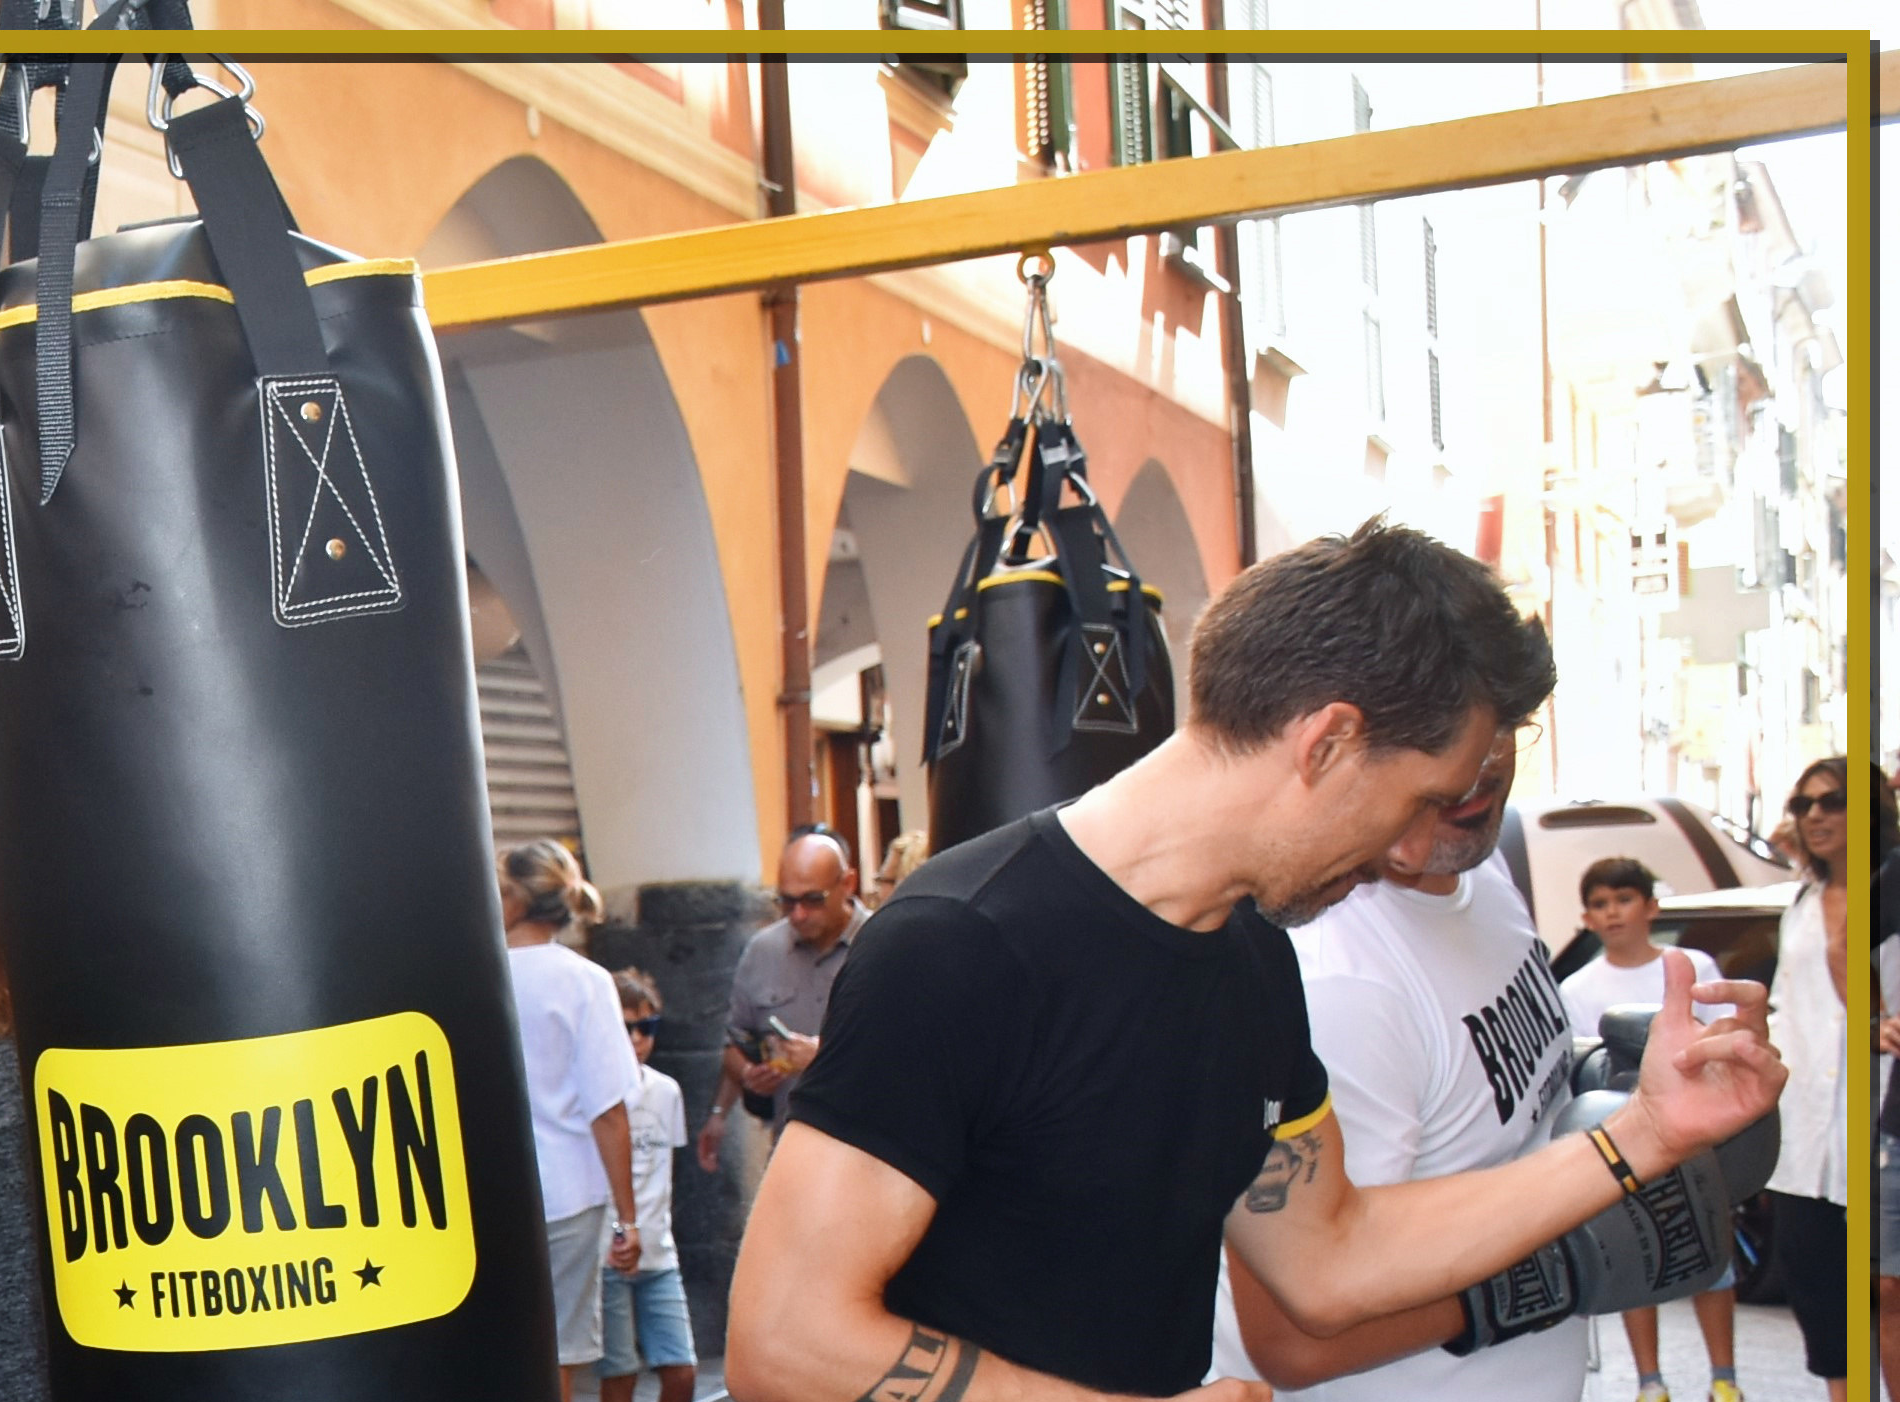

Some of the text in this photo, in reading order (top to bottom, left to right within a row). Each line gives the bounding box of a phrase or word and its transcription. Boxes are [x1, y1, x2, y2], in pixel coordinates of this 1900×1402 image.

[48, 1050, 448, 1263] BROOKLYN
[151, 1257, 337, 1319] FITBOXING
[1639, 1167, 1708, 1288] HARLIE
